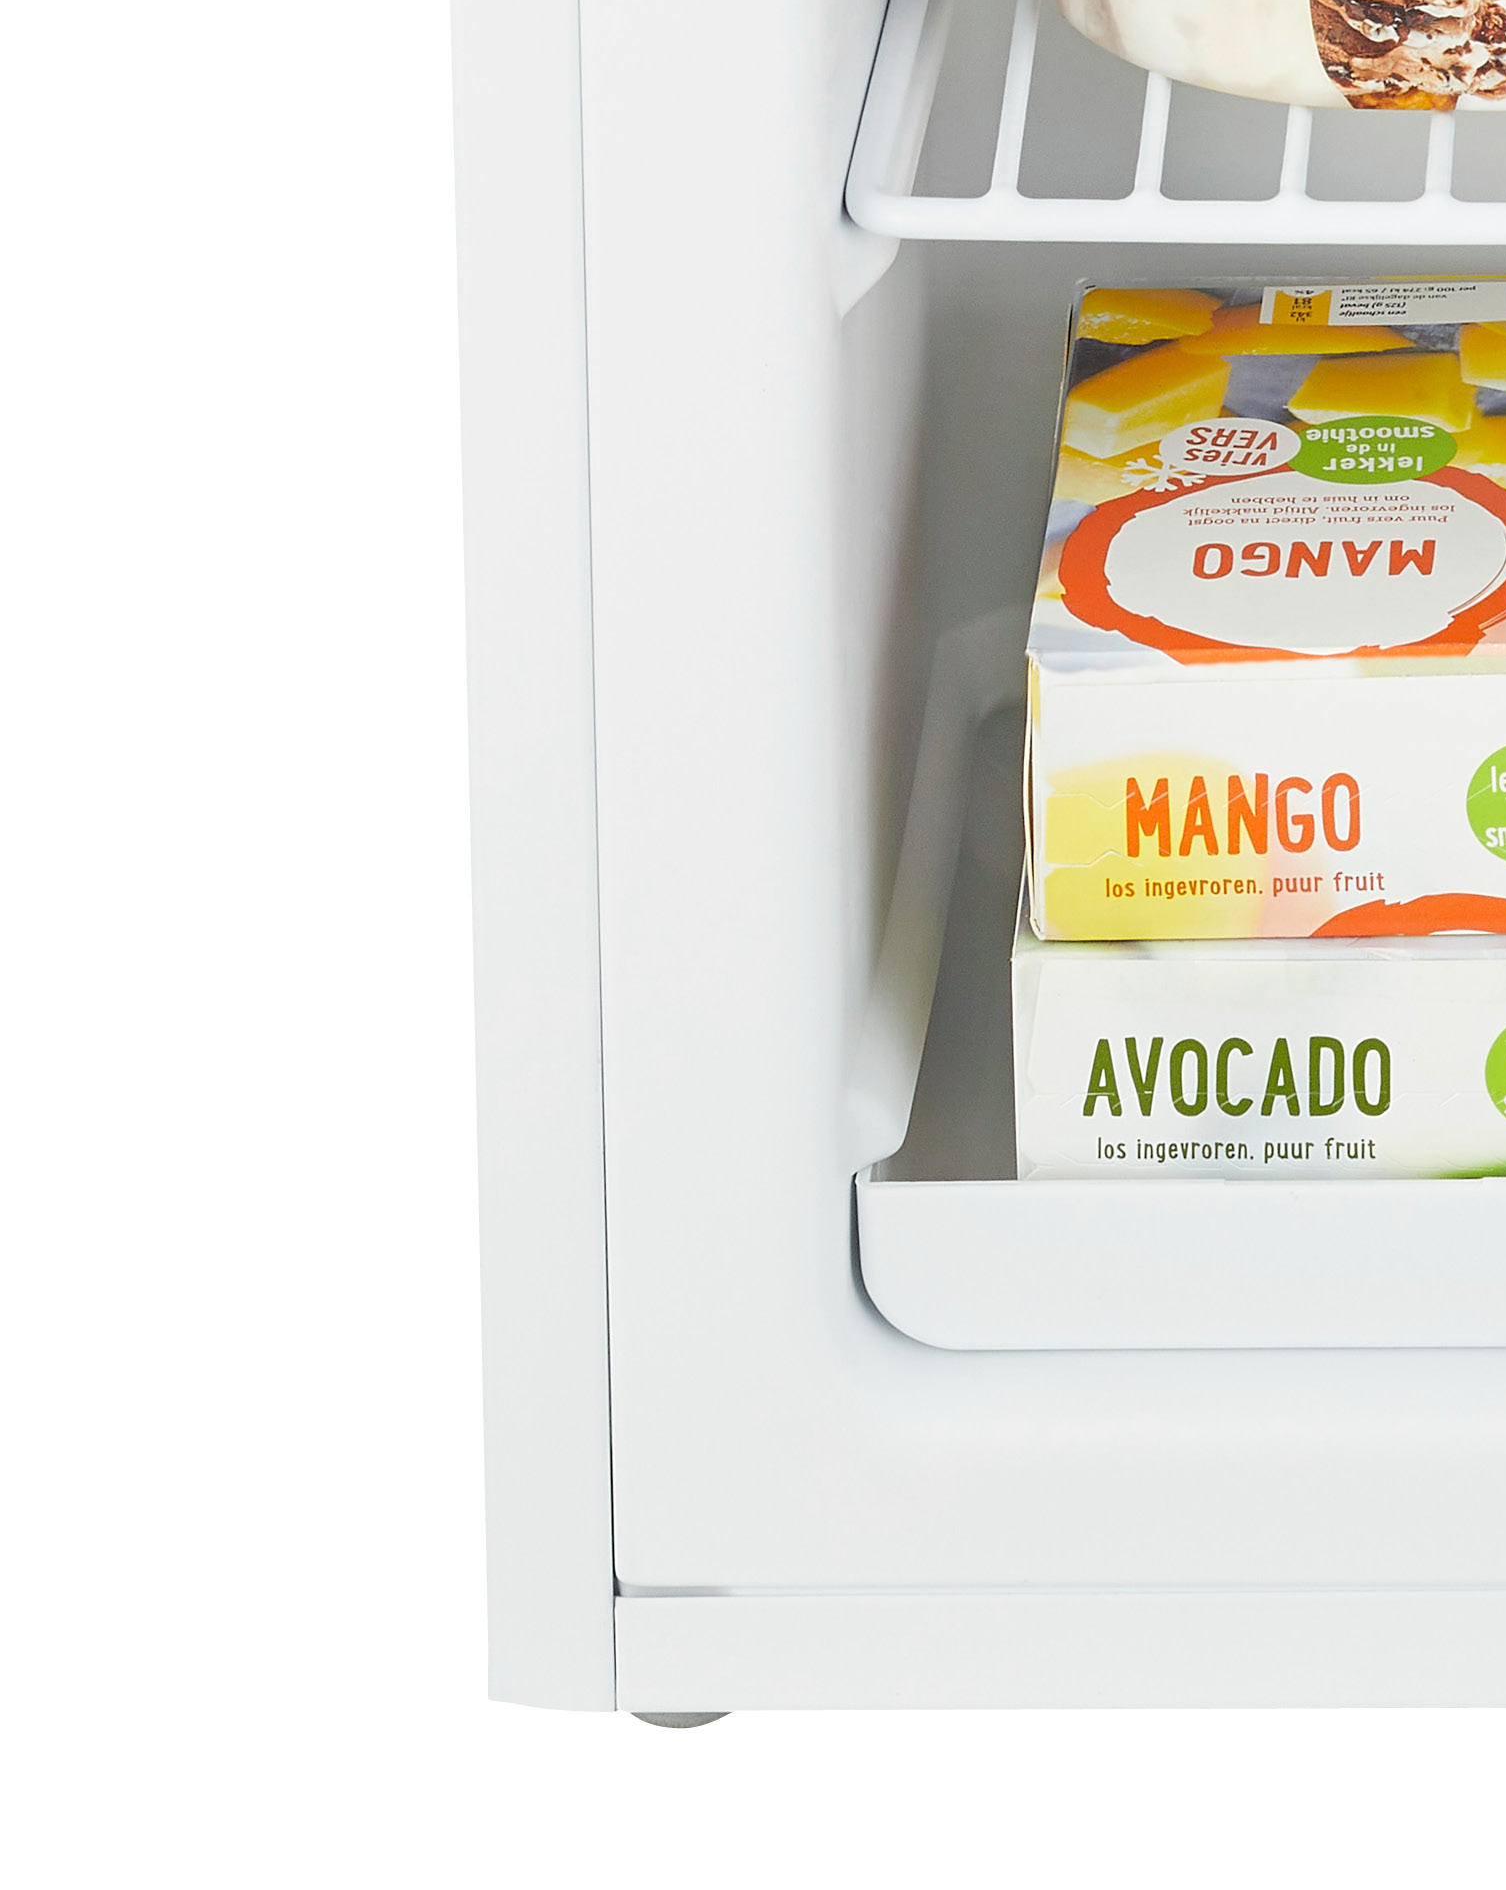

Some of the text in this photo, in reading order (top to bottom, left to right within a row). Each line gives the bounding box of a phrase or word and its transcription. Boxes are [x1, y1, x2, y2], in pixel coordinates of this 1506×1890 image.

[1186, 426, 1279, 452] VERS
[1306, 425, 1436, 444] smoothie
[1346, 443, 1396, 455] in de
[1183, 448, 1268, 467] vries
[1322, 455, 1424, 473] lekker
[1323, 496, 1357, 504] huis
[1183, 507, 1267, 516] makkelijk
[1273, 506, 1319, 515] Altijd
[1325, 504, 1425, 513] ingevroren.
[1188, 517, 1235, 526] oogst
[1265, 517, 1316, 525] direct
[1322, 516, 1361, 524] fruit,
[1409, 515, 1448, 523] Puur
[1192, 539, 1436, 581] MANGO
[1125, 772, 1361, 859] MANGO
[1105, 871, 1386, 901] los ingevroren. puur fruit
[1082, 1036, 1392, 1117] AVOCADO
[1097, 1137, 1377, 1164] los ingevroren. puur fruit
